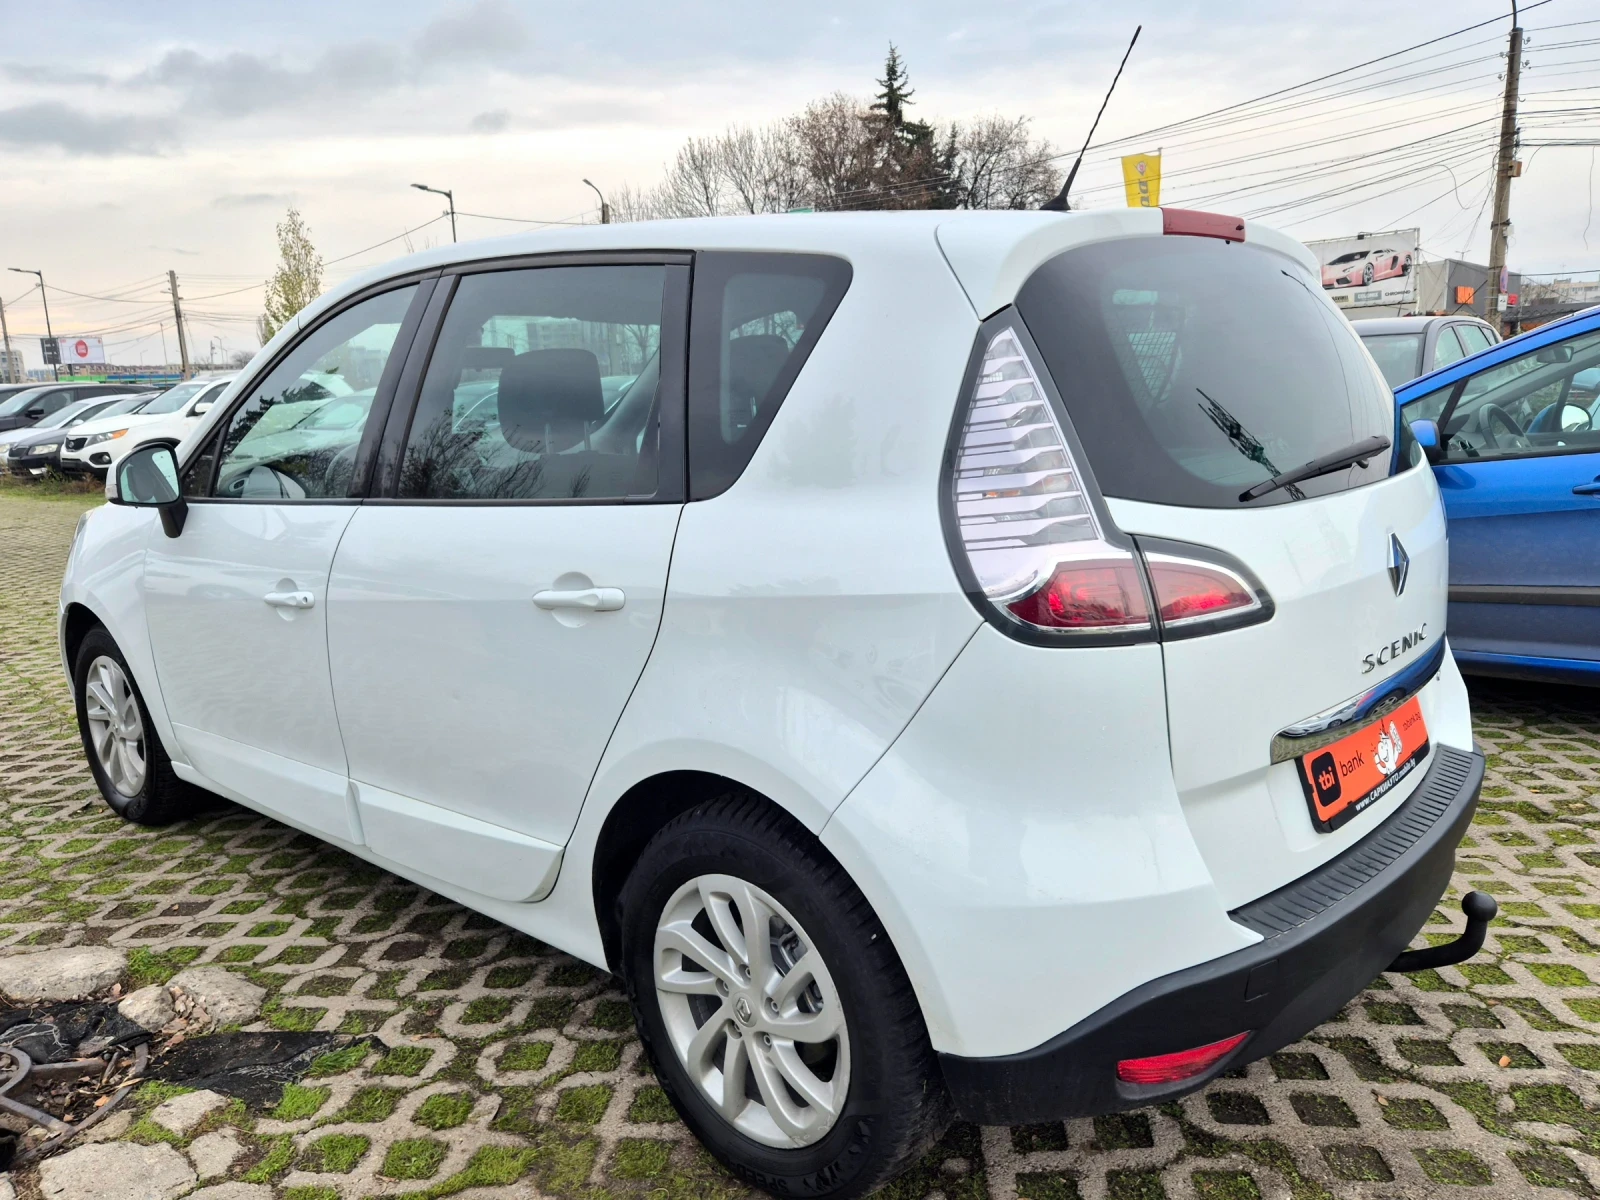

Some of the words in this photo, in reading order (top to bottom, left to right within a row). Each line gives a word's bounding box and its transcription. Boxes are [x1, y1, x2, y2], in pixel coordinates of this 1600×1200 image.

[1361, 622, 1427, 674] SCENIC
[1318, 767, 1336, 791] tbi
[1338, 750, 1365, 777] bank
